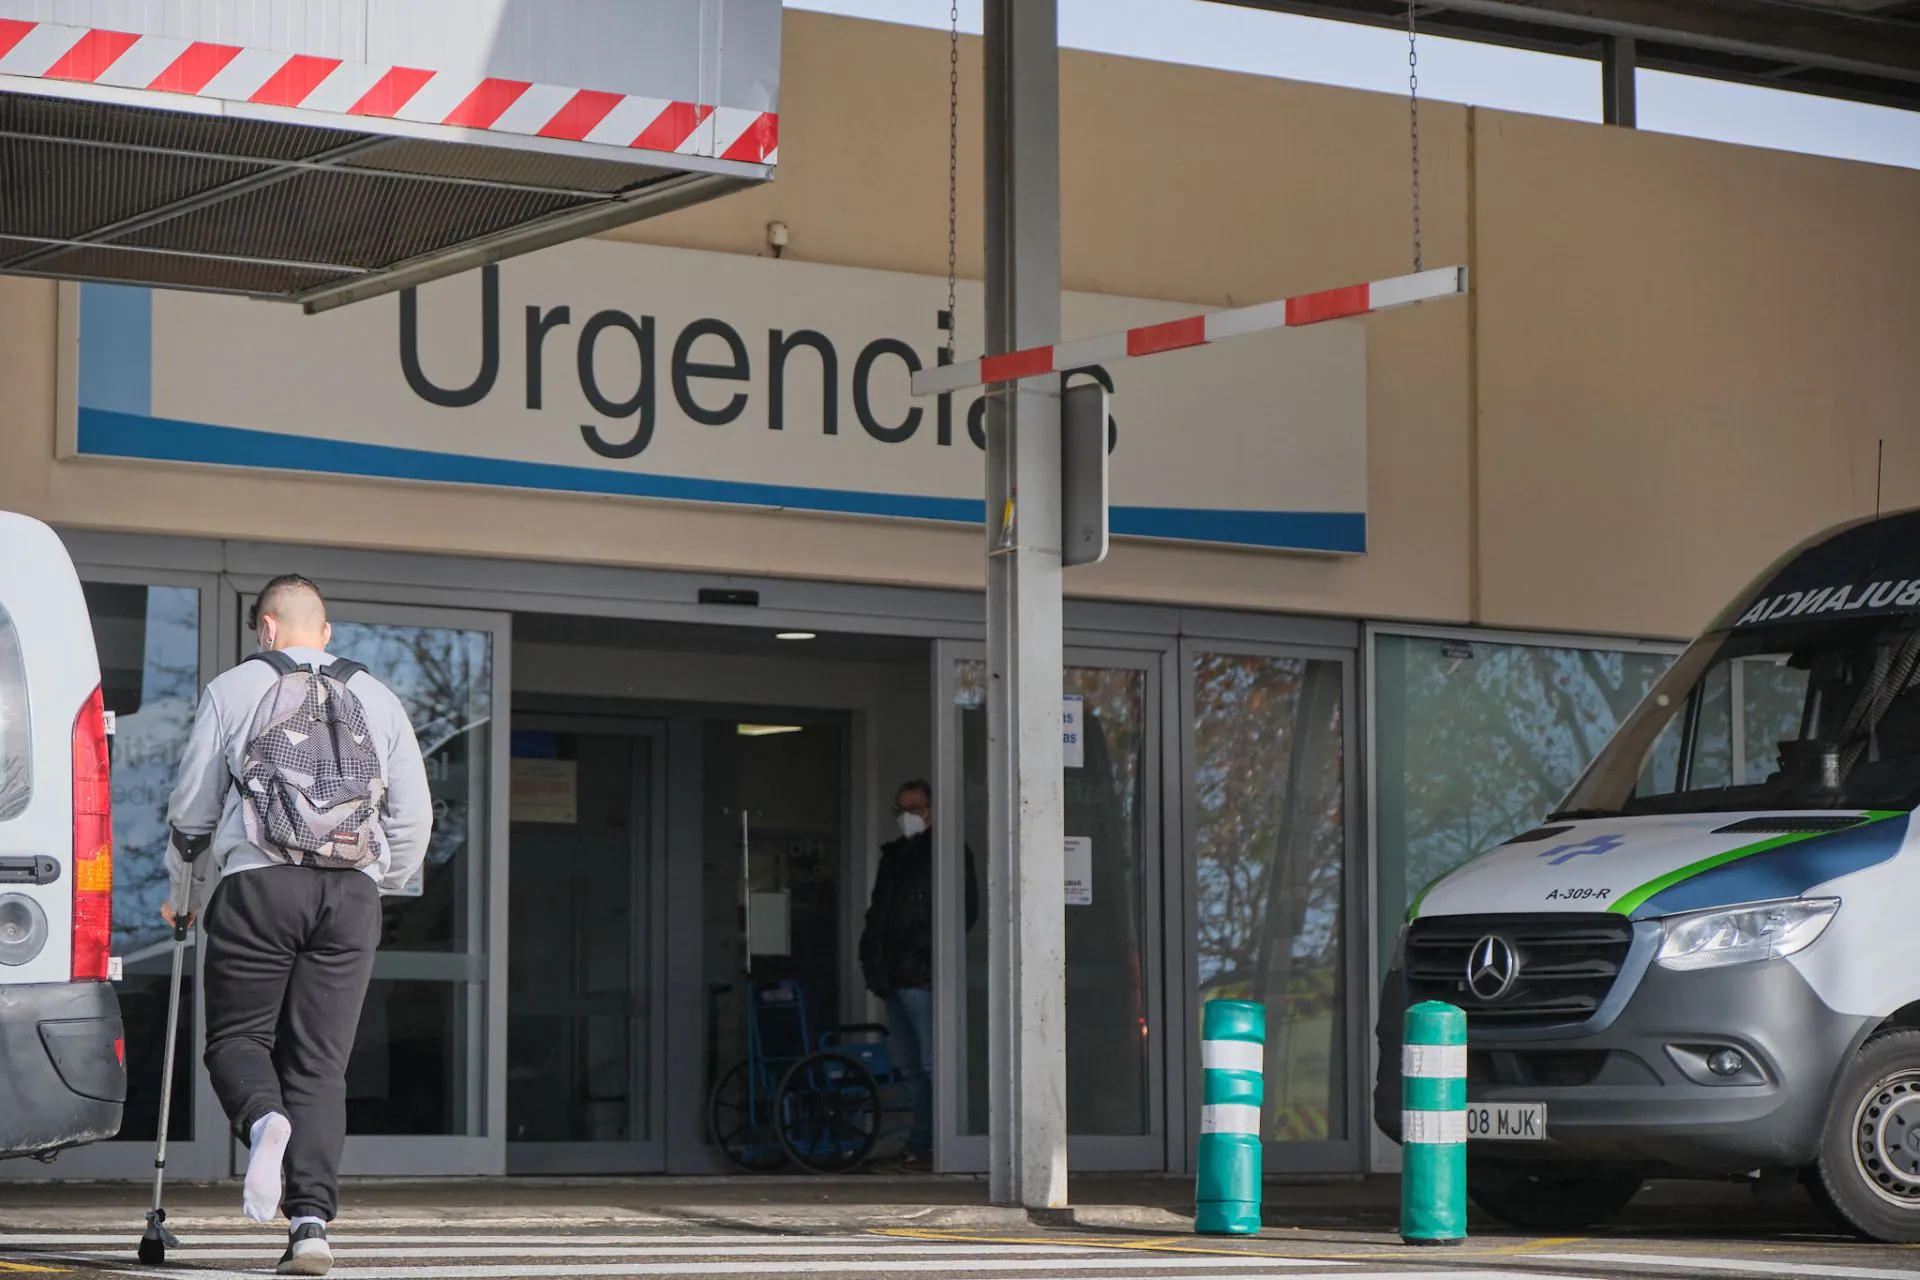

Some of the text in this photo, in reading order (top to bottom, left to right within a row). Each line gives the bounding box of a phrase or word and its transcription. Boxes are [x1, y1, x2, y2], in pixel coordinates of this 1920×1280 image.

[400, 263, 1117, 459] Urgenci
[1545, 887, 1612, 900] A-309-R
[1467, 1108, 1536, 1136] 08 MJK
